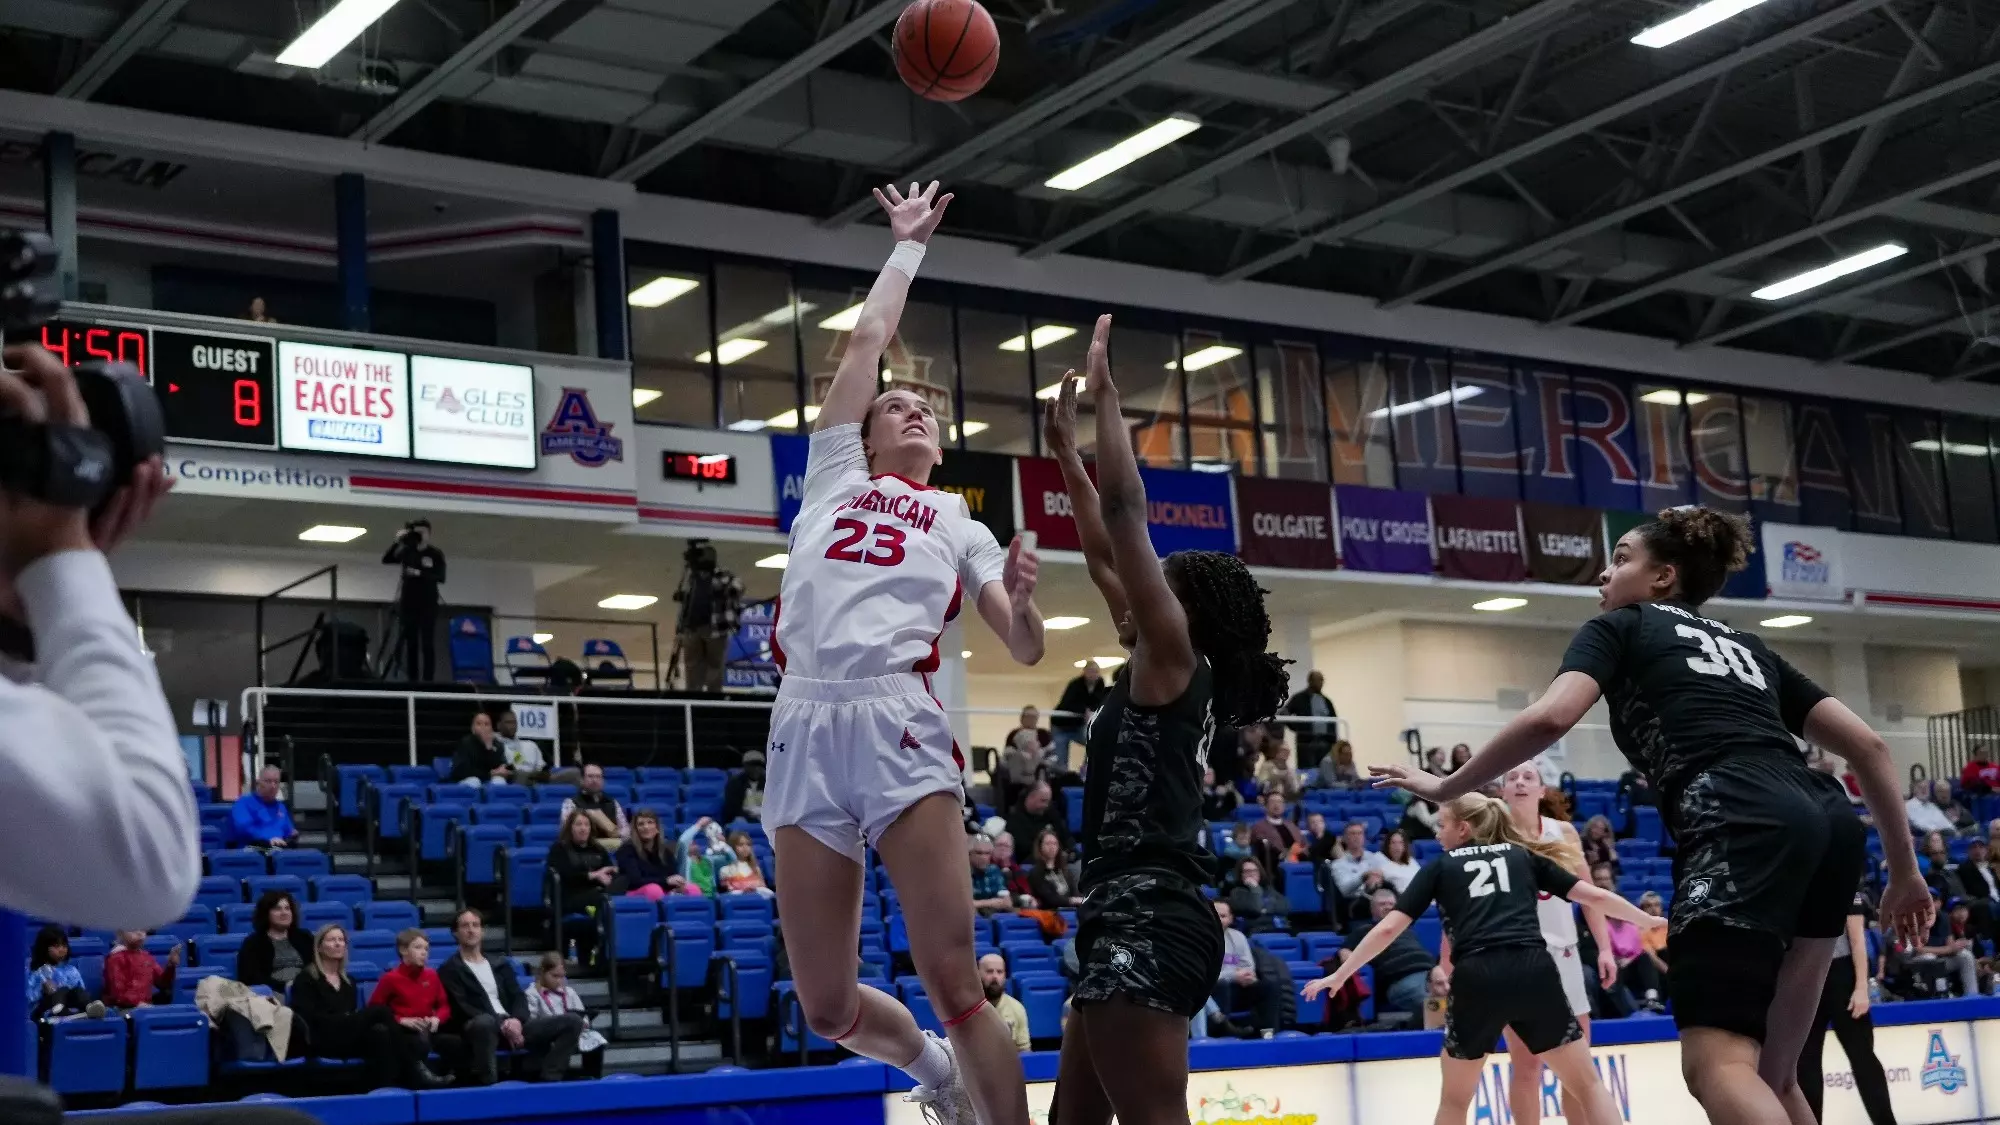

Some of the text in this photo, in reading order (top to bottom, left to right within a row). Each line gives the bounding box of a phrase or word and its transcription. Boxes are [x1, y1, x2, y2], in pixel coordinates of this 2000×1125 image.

[42, 326, 144, 376] 4:50
[192, 345, 260, 373] GUEST
[295, 356, 393, 383] FOLLOW THE
[234, 379, 261, 426] 8
[295, 379, 395, 419] EAGLES
[420, 383, 527, 412] EAGLES
[466, 407, 525, 427] CLUB
[1138, 328, 1953, 534] AMERICAN
[179, 459, 344, 489] Competition
[1147, 500, 1228, 530] UCKNELL
[1252, 511, 1328, 540] COLGATE
[824, 516, 907, 567] 23
[1341, 516, 1430, 545] HOLY CROSS
[1437, 526, 1519, 554] LAFAYETTE
[1537, 532, 1592, 558] LEHIGH
[1674, 623, 1768, 691] 30
[520, 711, 547, 730] 103
[1463, 856, 1511, 898] 21
